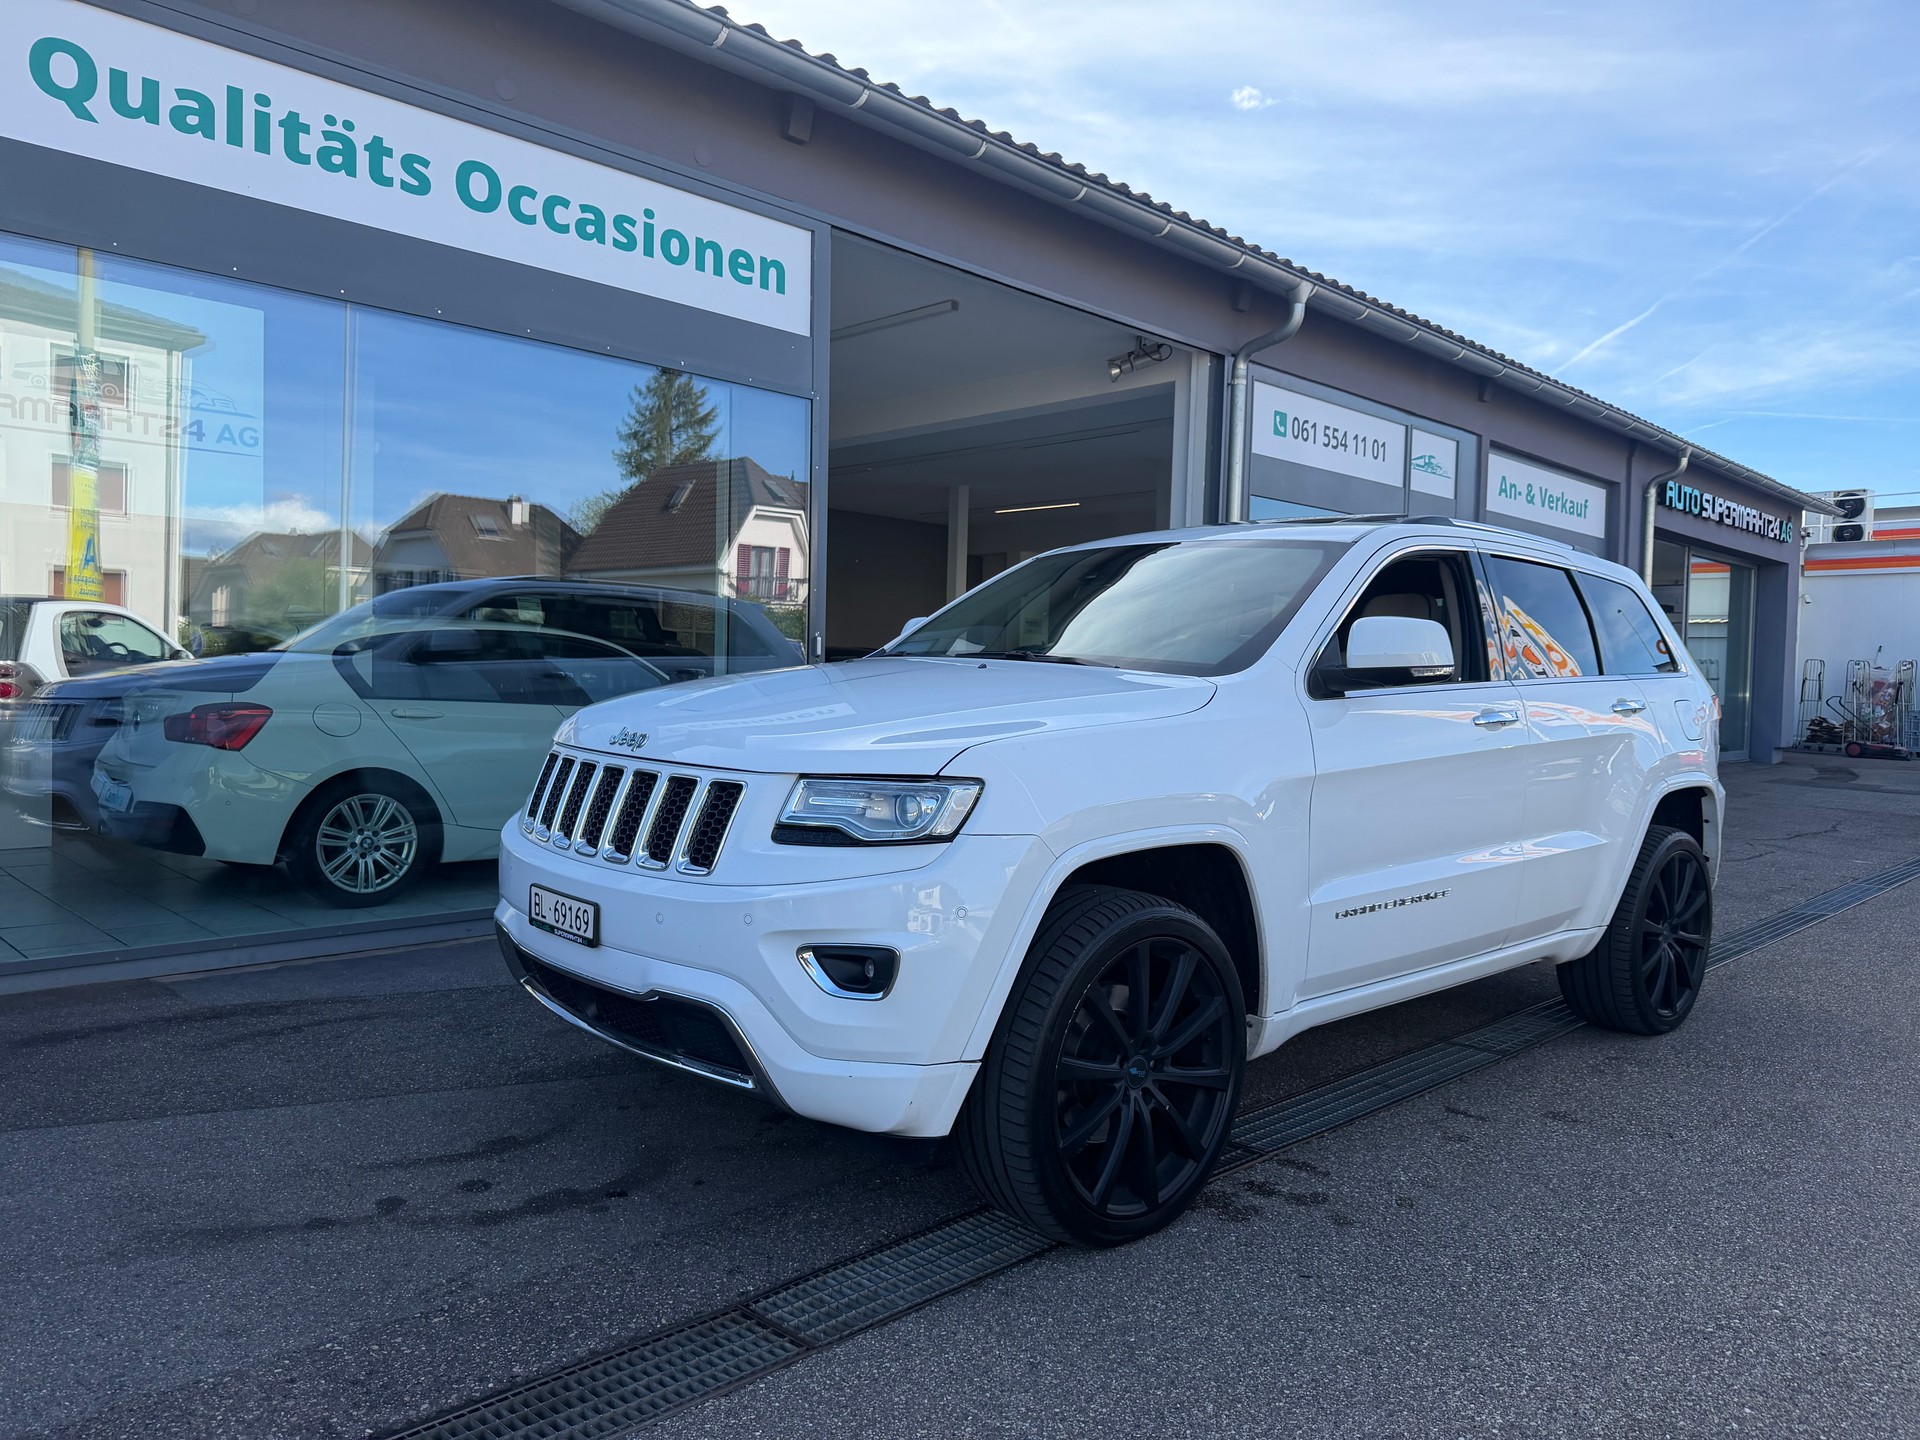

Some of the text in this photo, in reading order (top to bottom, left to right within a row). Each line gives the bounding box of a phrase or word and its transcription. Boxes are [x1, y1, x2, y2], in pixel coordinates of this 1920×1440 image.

[28, 36, 787, 296] Qualitäts Occasionen
[215, 423, 260, 448] AG
[1292, 416, 1387, 463] 061 554 11 01
[1498, 475, 1588, 519] An- & Verkauf
[1666, 480, 1793, 543] AUTO SUPERMARKT24 AG
[609, 726, 649, 752] Jeep
